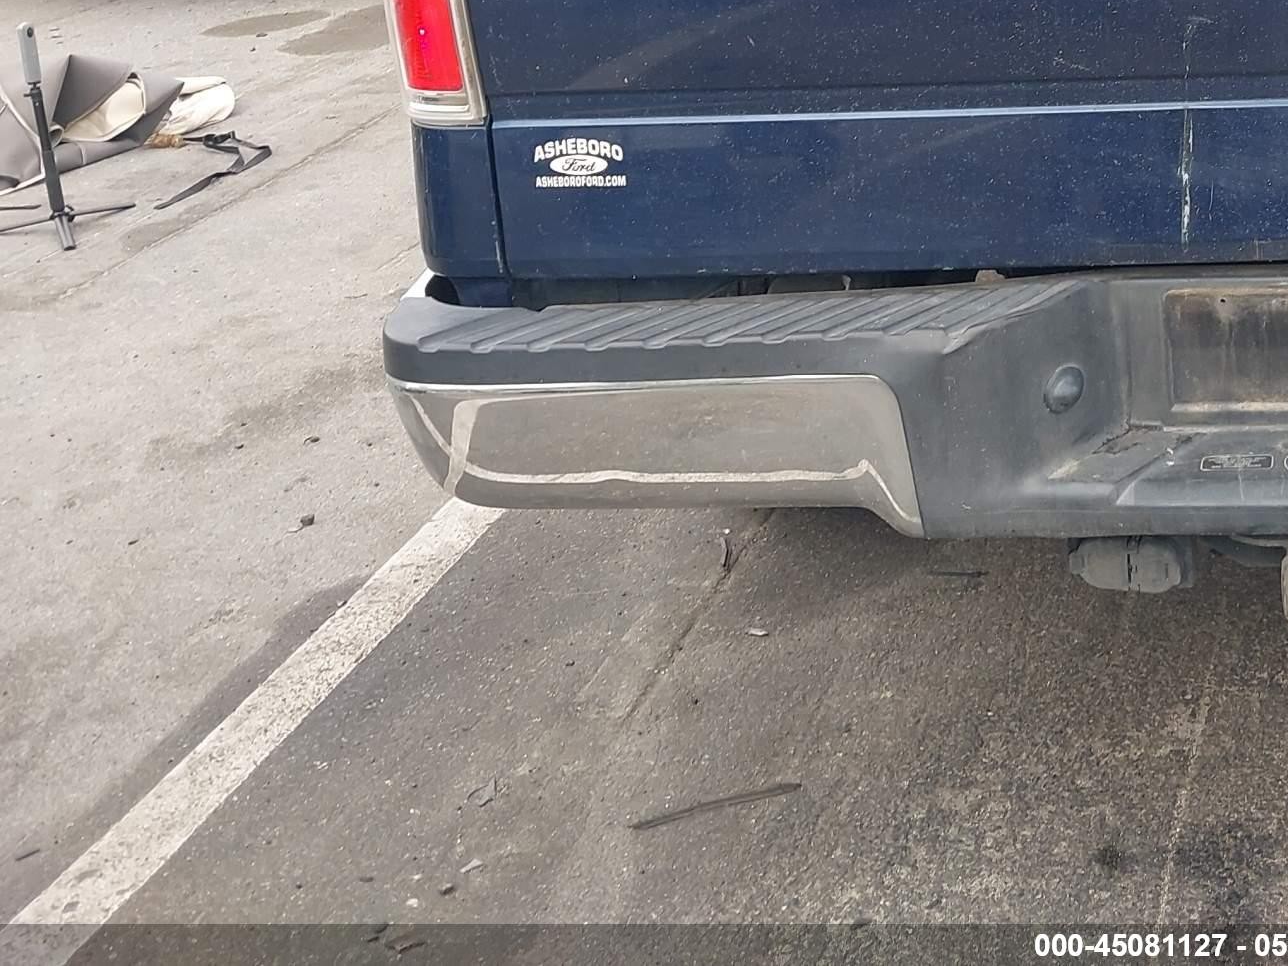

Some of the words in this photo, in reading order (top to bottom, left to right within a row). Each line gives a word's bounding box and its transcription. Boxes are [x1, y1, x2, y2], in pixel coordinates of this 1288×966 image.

[534, 137, 624, 163] ASHEBORO
[561, 157, 597, 173] Ford
[535, 175, 627, 188] ASHEBOROFORD.COM
